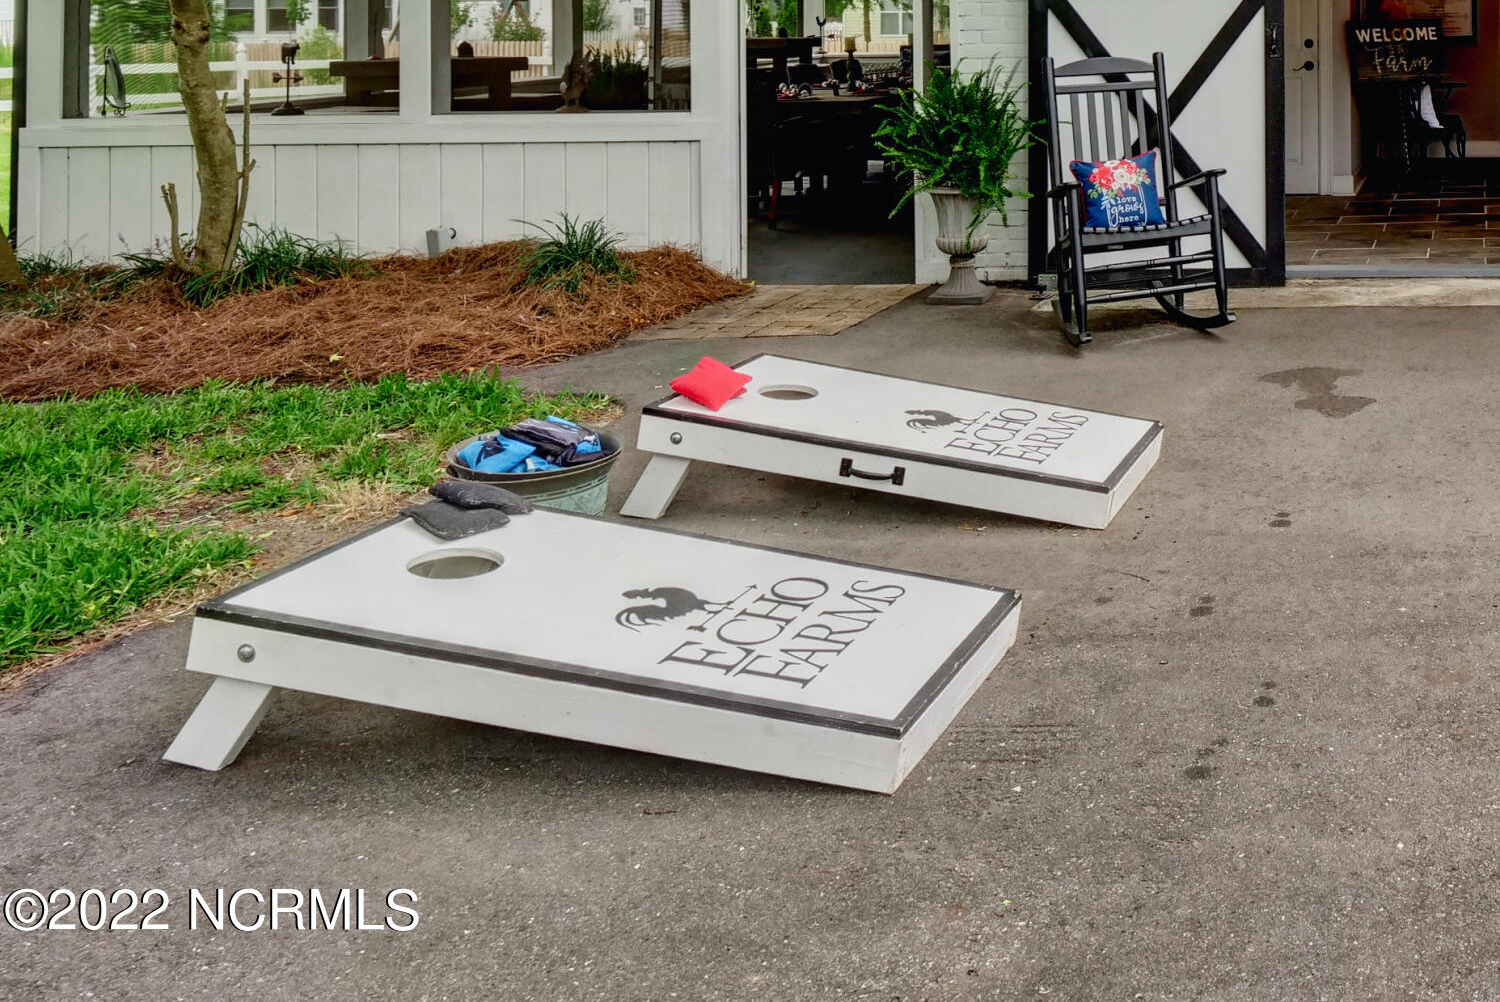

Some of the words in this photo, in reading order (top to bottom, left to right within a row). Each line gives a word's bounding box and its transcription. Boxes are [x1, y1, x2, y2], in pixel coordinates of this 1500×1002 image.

[1355, 26, 1438, 43] WELCOME
[1364, 46, 1432, 75] Farm
[1110, 202, 1145, 226] grows
[1115, 196, 1137, 204] love
[1118, 215, 1139, 223] here
[944, 408, 1038, 456] ECHO
[993, 411, 1089, 464] FARMS
[657, 576, 829, 676] ECHO
[733, 579, 906, 689] FARMS
